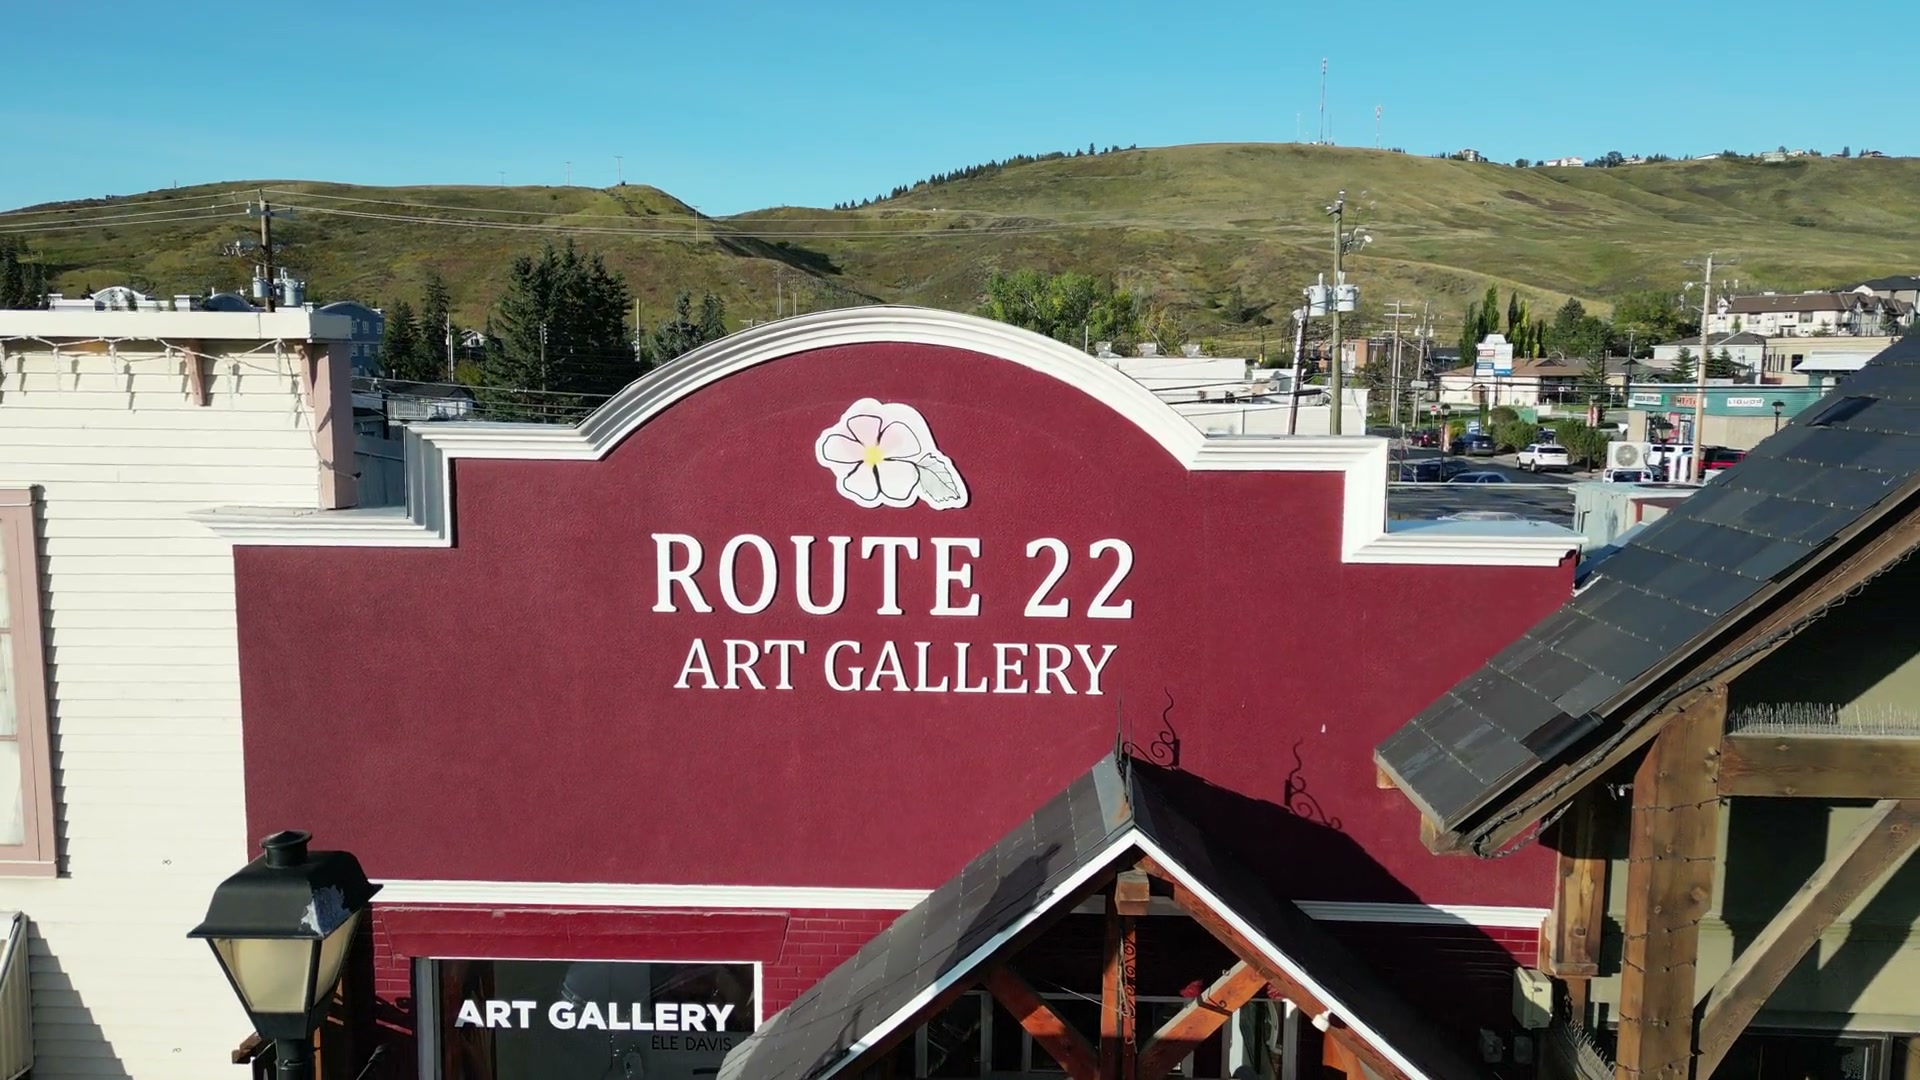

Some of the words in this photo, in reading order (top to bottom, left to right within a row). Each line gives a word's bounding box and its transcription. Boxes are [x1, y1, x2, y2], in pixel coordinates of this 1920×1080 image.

[650, 532, 981, 618] ROUTE
[1023, 537, 1134, 620] 22
[673, 637, 806, 691] ART
[823, 640, 1118, 697] GALLERY
[455, 999, 537, 1029] ART
[548, 1001, 735, 1032] GALLERY
[651, 1035, 679, 1051] ELE
[685, 1036, 732, 1052] DAVIS
